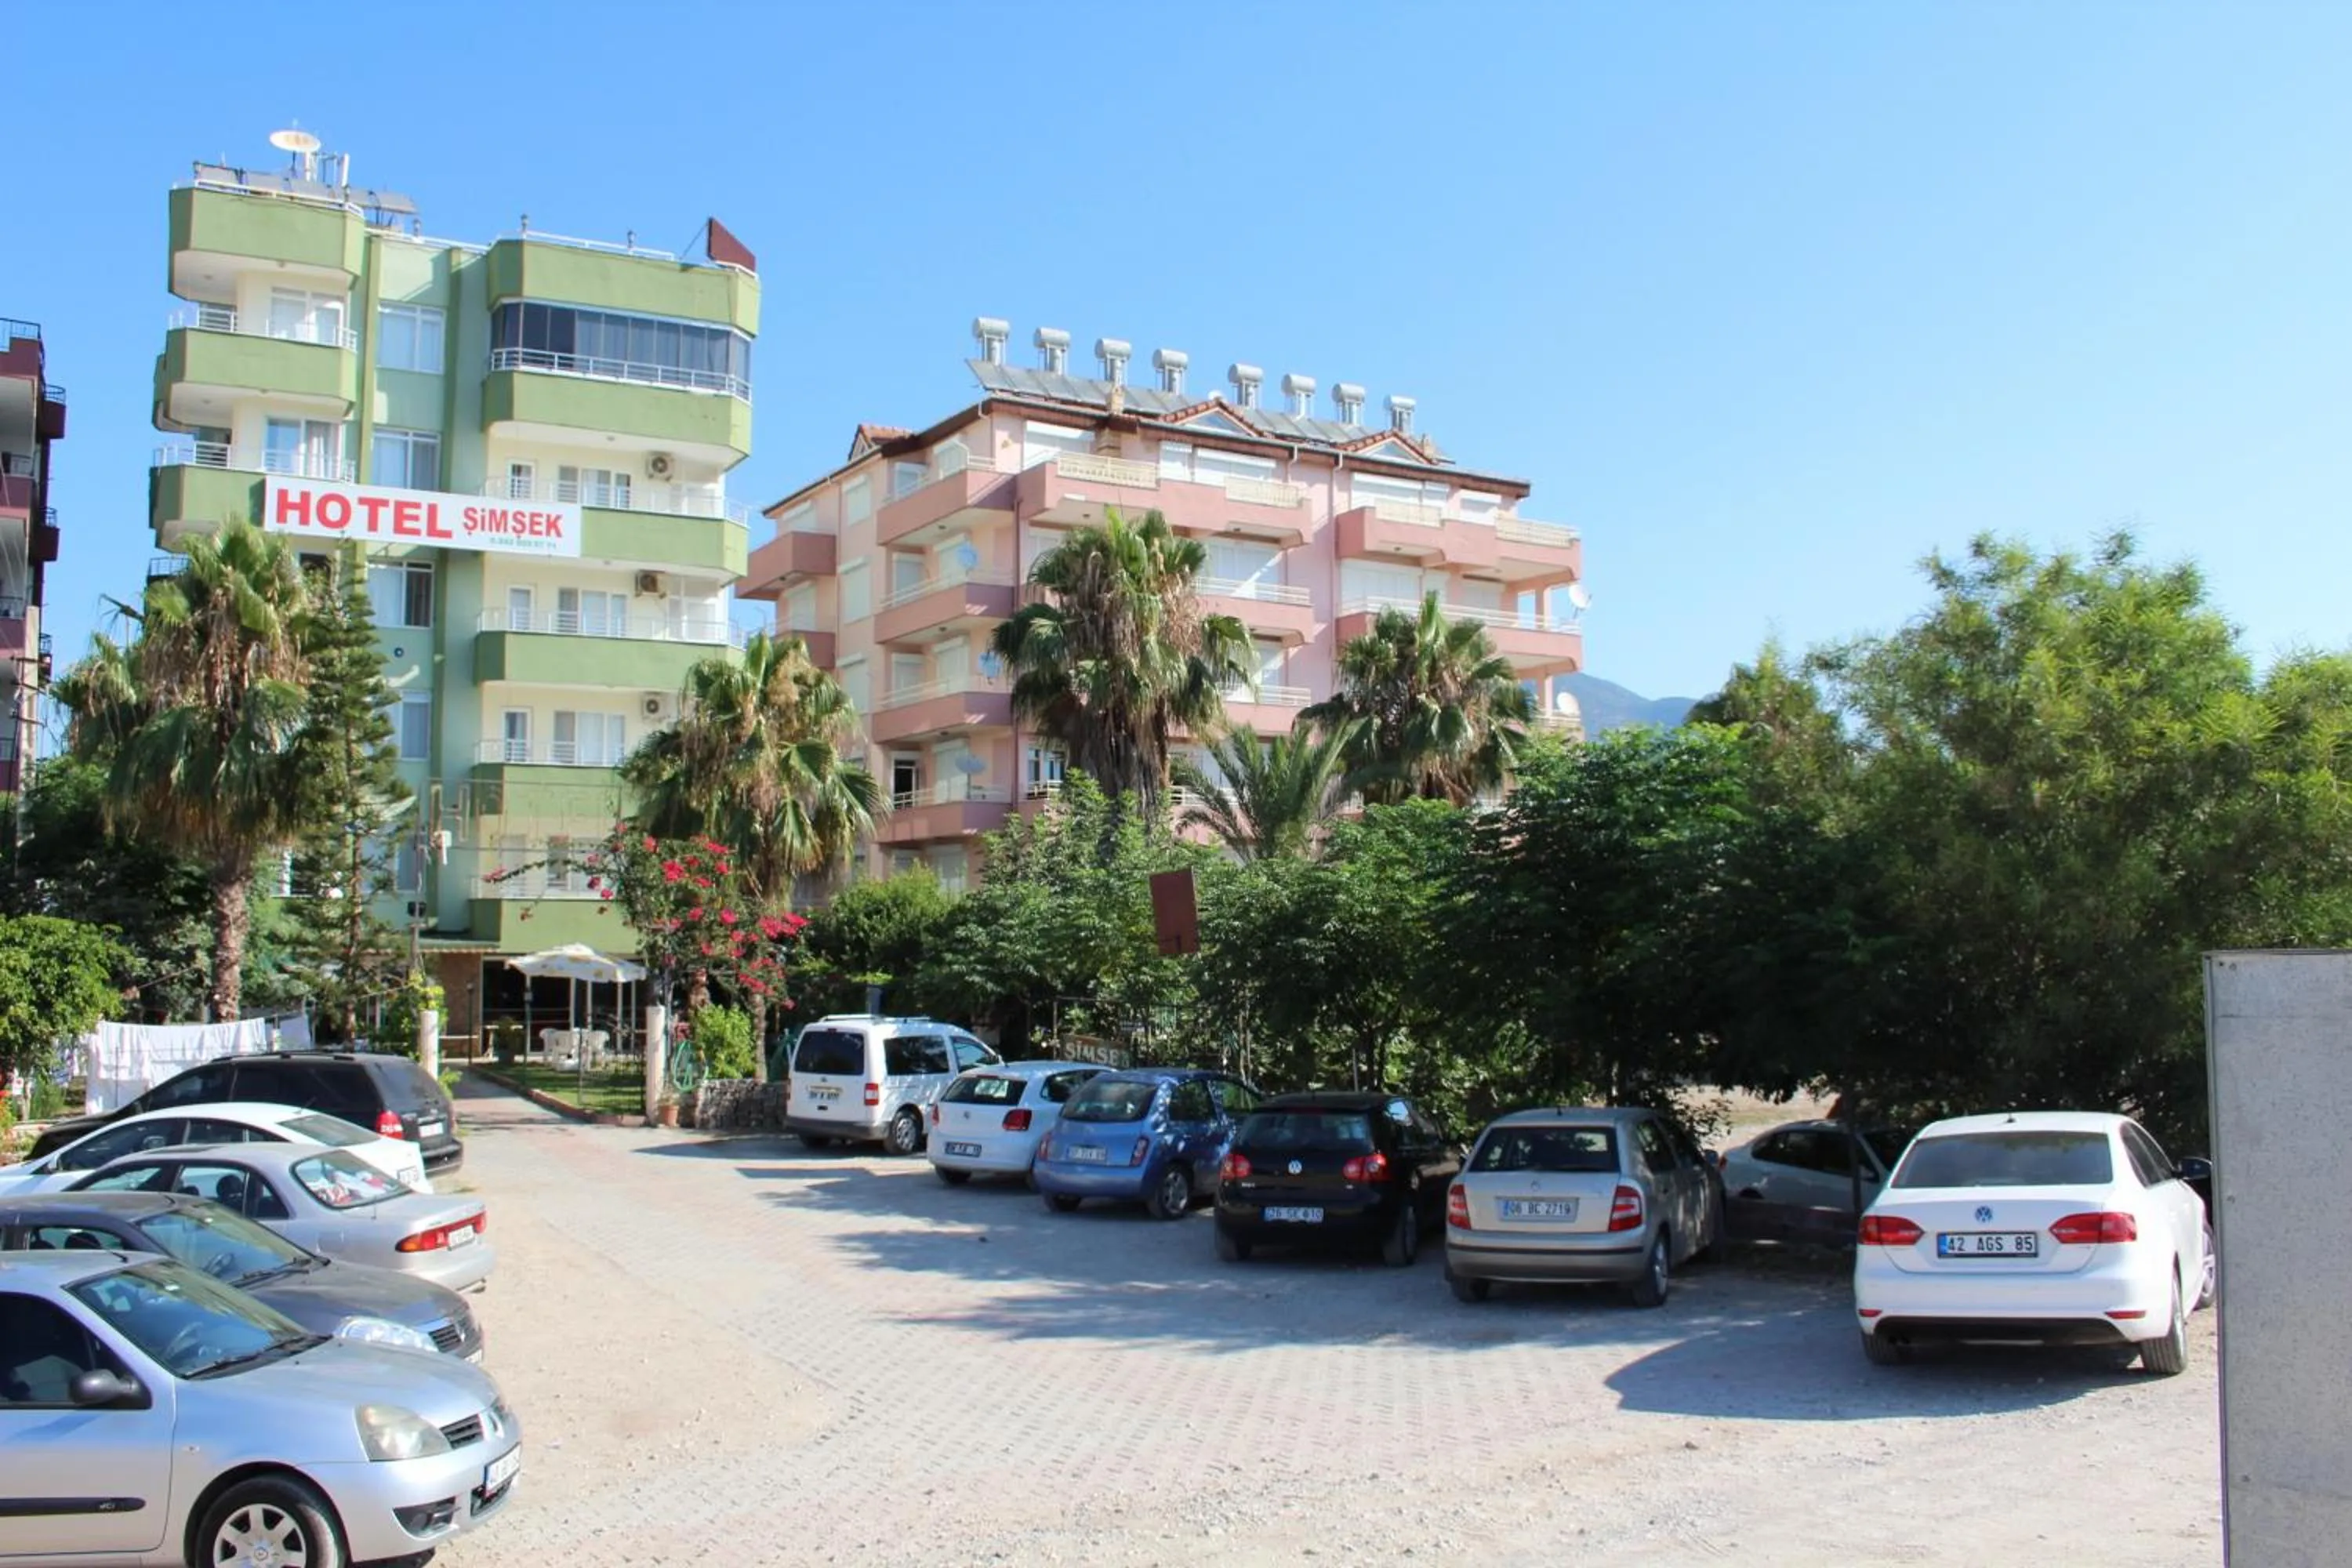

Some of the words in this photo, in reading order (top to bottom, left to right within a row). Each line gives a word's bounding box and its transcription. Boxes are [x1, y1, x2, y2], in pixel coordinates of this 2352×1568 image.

[276, 488, 453, 539] HOTEL
[1949, 1236, 1966, 1252] 42
[1976, 1236, 2003, 1251] AGS
[2014, 1236, 2033, 1251] 85
